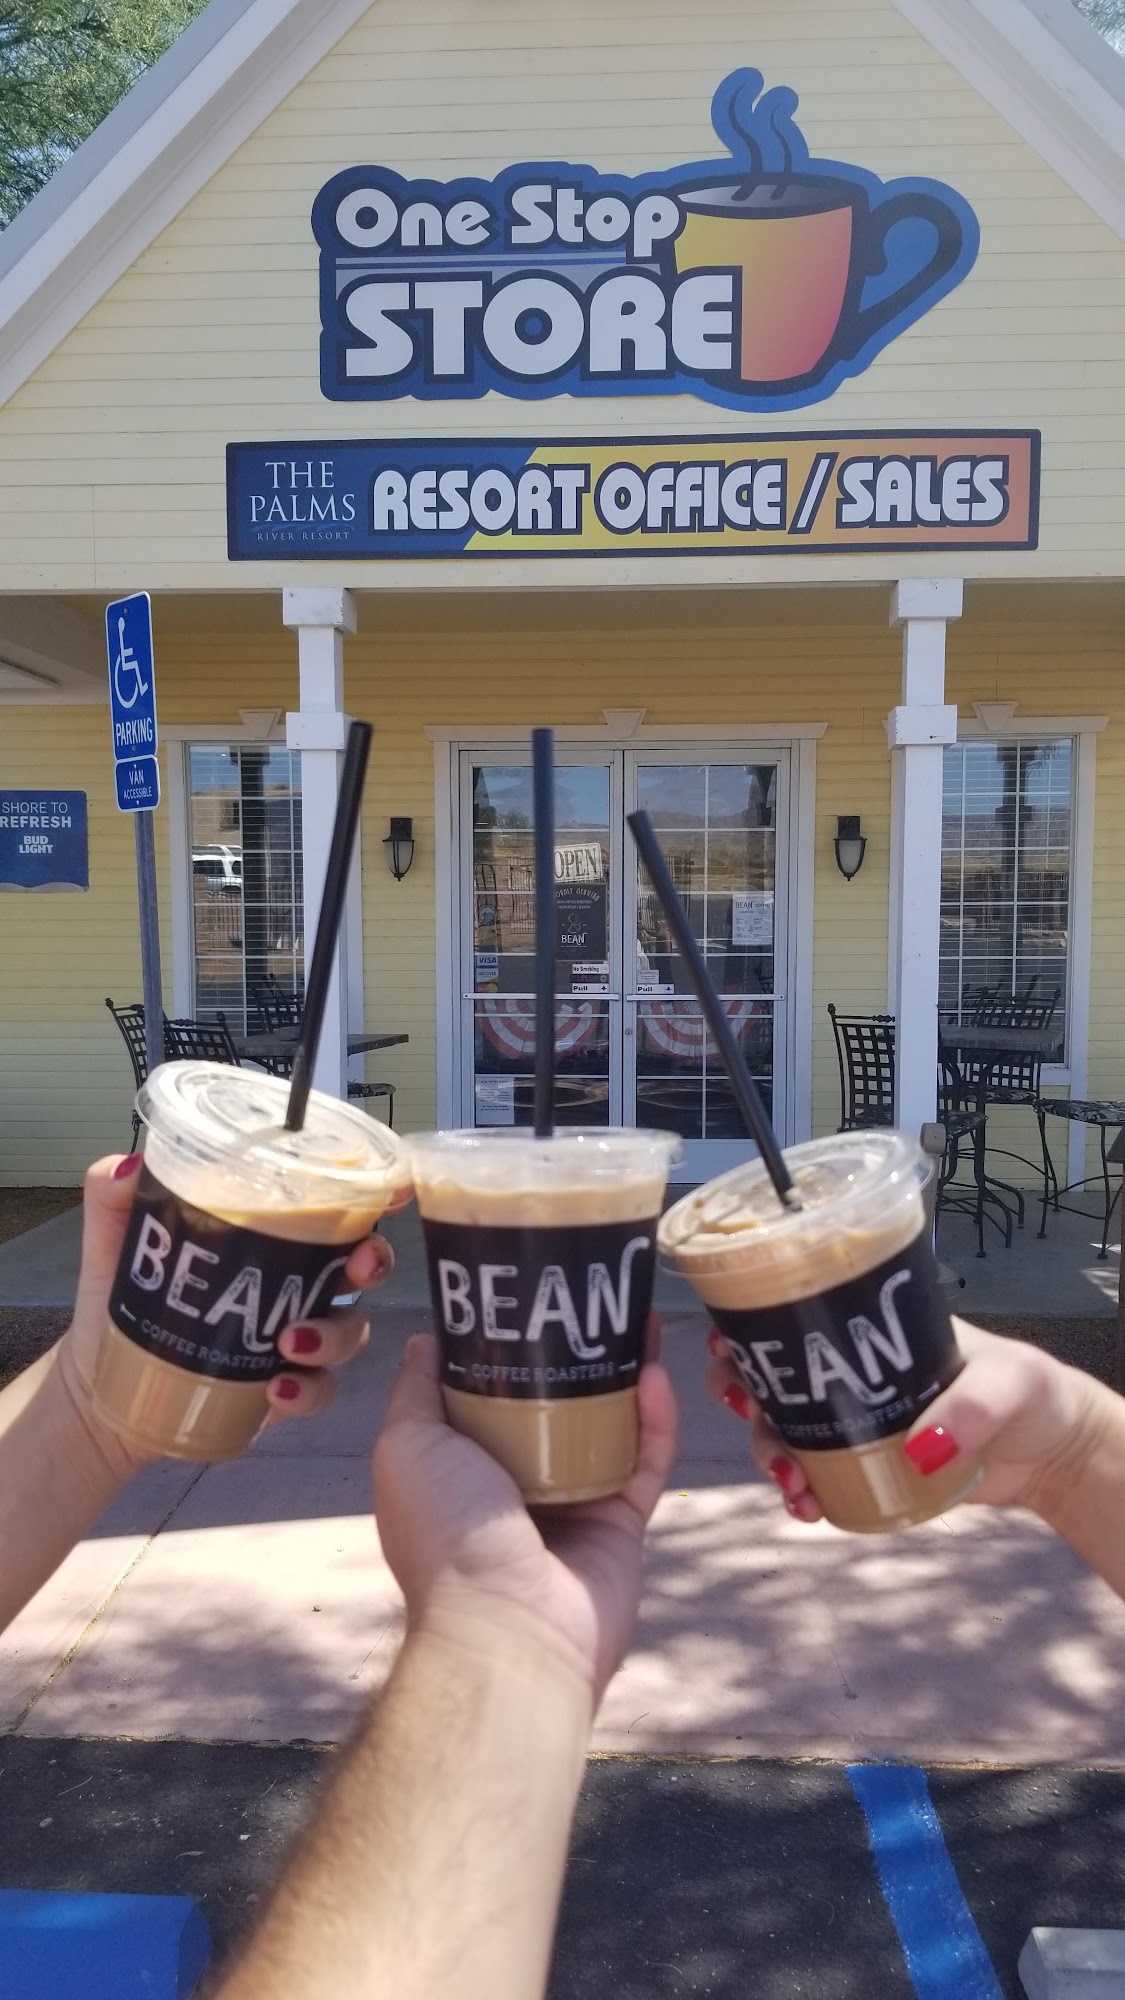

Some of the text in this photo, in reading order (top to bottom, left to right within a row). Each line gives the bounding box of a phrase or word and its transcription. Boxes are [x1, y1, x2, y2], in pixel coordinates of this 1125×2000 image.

[335, 184, 680, 258] One Stop
[345, 274, 733, 377] STORE
[264, 461, 335, 489] THE
[249, 493, 356, 522] PALMS
[373, 458, 1004, 531] RESORT OFFICE / SALES
[257, 531, 350, 541] RIVER RESORT
[115, 716, 153, 747] PARKING
[128, 769, 144, 785] VAN
[123, 786, 152, 800] ACCESSIBLE
[0, 815, 72, 828] REFRESH
[1, 802, 68, 814] SHORE TO
[18, 844, 54, 854] LIGHT
[23, 835, 49, 845] BUD
[554, 848, 597, 879] OPEN
[561, 932, 588, 946] BEAN
[479, 956, 497, 964] VISA
[129, 1212, 348, 1354] BEAN
[438, 1236, 650, 1361] BEAN
[140, 1318, 195, 1356] COFFEE
[724, 1268, 915, 1406] BEAN
[470, 1361, 615, 1383] COFFEE ROASTERS
